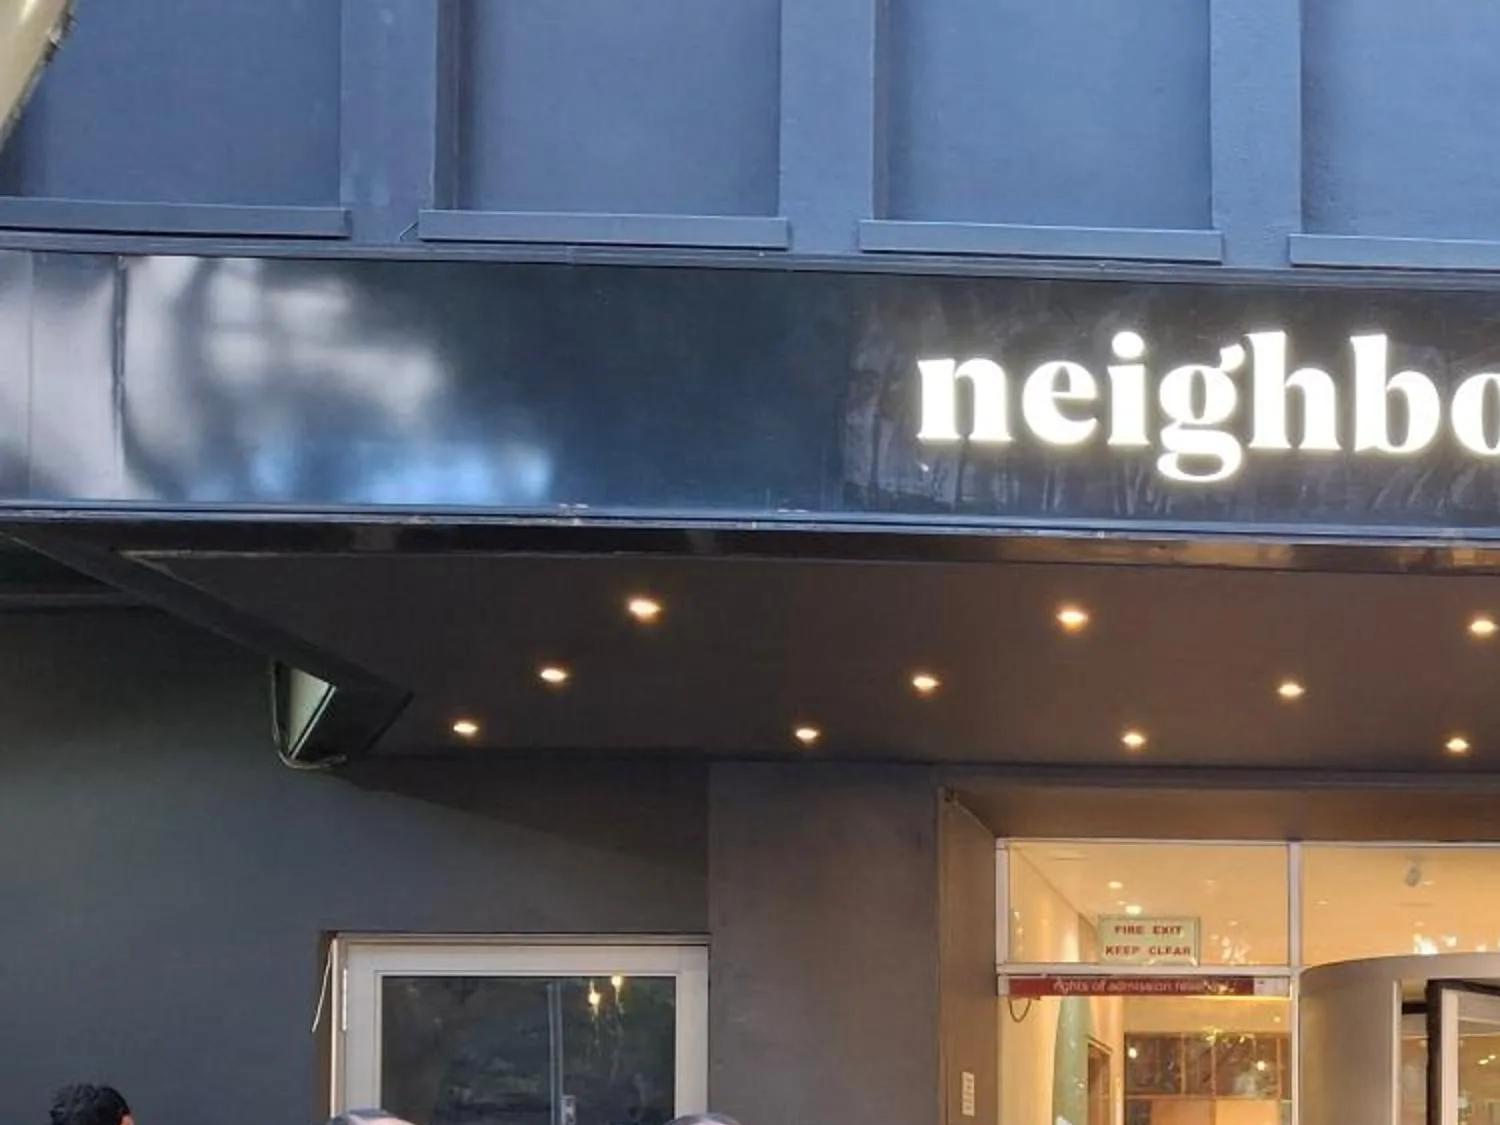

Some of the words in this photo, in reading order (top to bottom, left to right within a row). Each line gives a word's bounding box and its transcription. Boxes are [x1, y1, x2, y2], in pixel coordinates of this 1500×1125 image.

[1114, 925, 1144, 935] FIRE
[1153, 925, 1182, 935] EXIT
[1105, 945, 1140, 957] KEEP
[1148, 945, 1191, 957] CLEAR
[1091, 980, 1106, 991] of
[1107, 980, 1172, 992] admission
